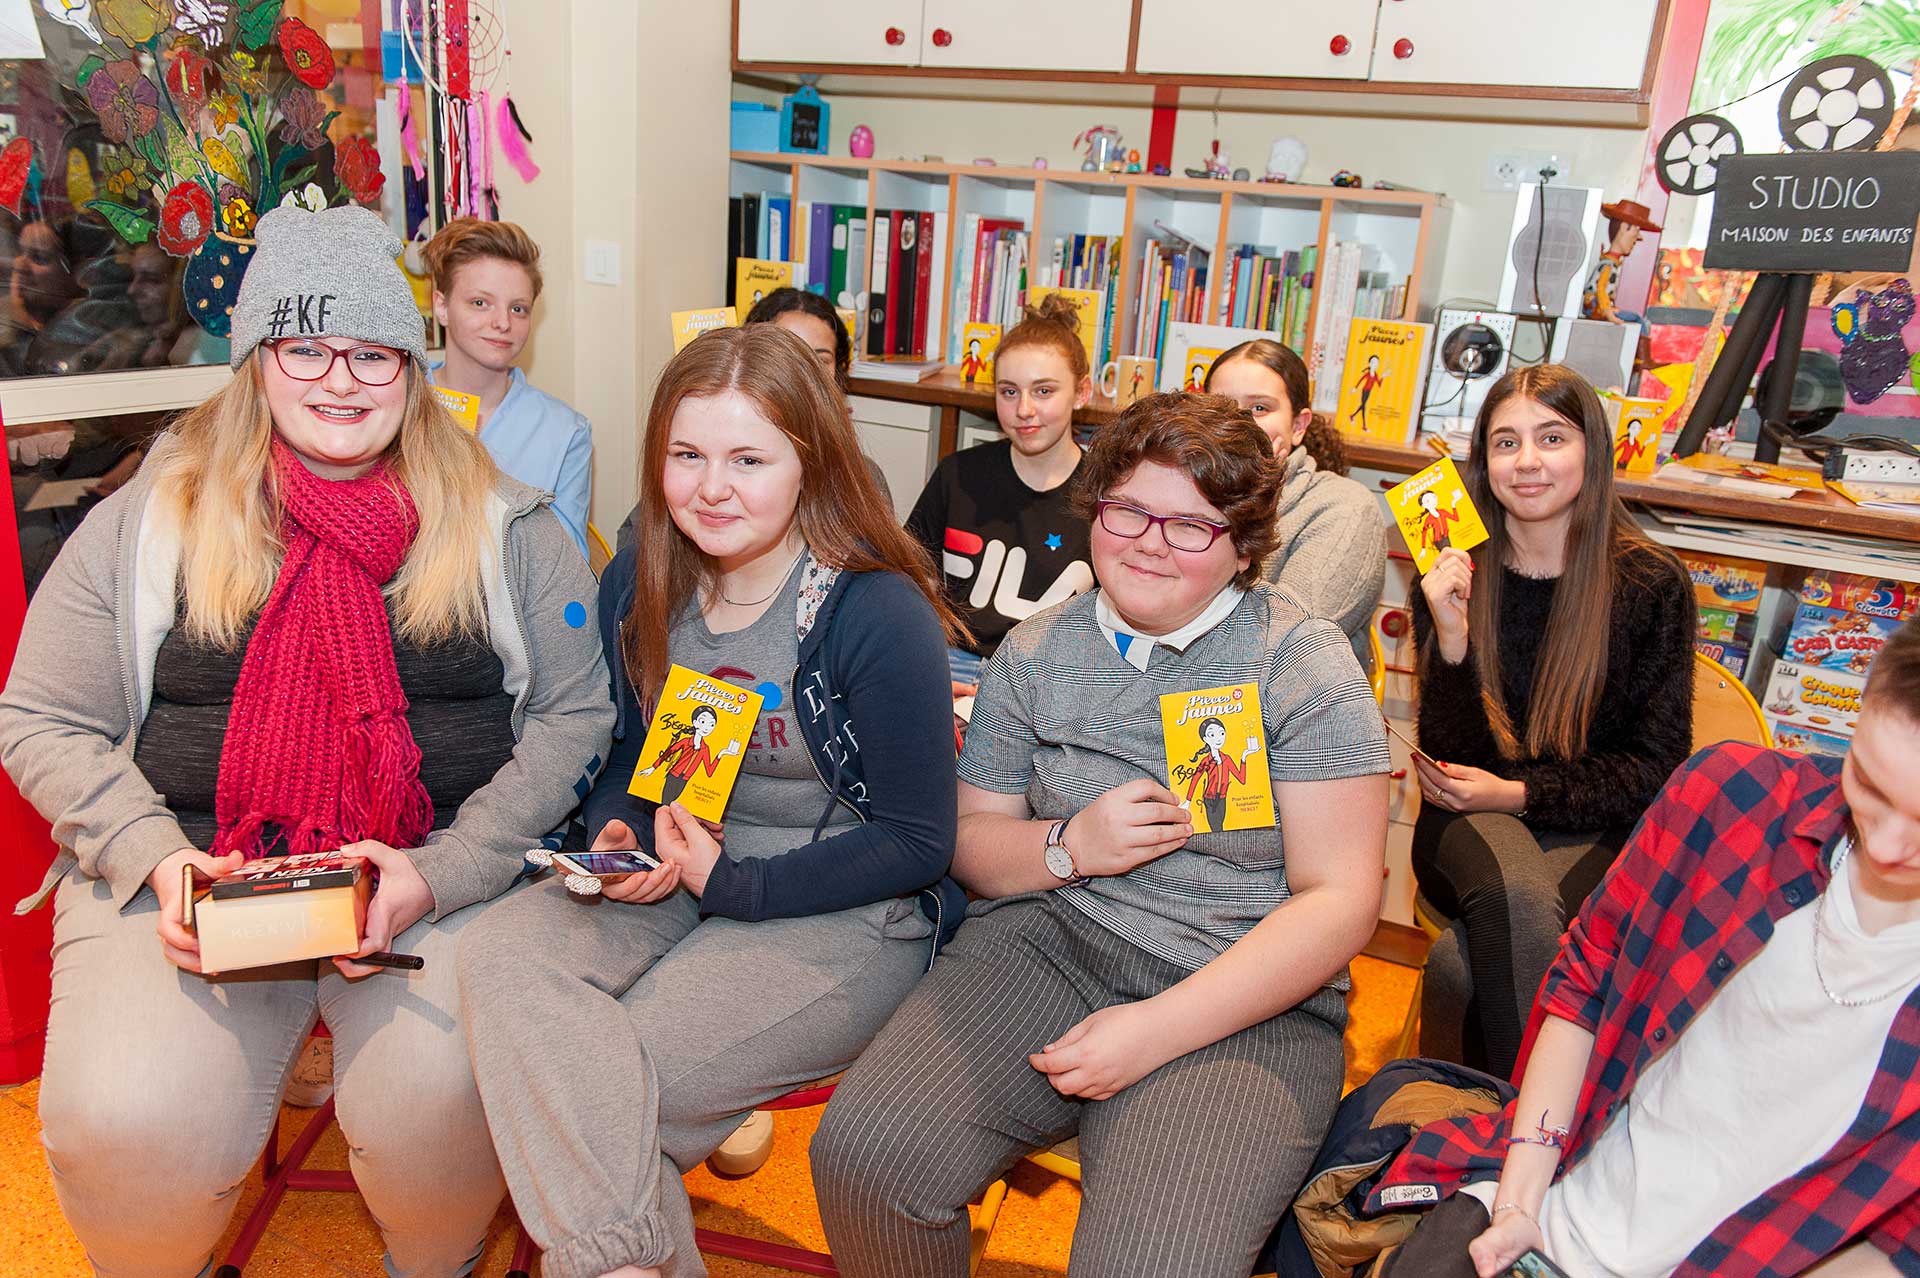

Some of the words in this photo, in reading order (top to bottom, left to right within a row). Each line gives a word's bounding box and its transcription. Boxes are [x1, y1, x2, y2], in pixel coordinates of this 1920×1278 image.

[1750, 175, 1880, 209] STUDIO
[1721, 227, 1789, 242] MAISON
[1801, 228, 1833, 243] DES
[1842, 227, 1912, 244] ENFANTS
[267, 294, 336, 336] #KF
[943, 527, 1095, 621] FILA
[1866, 581, 1896, 608] 5
[1793, 636, 1832, 653] CATA
[676, 684, 743, 715] jaunes
[1800, 676, 1861, 698] Croque
[1176, 701, 1244, 726] jaunes
